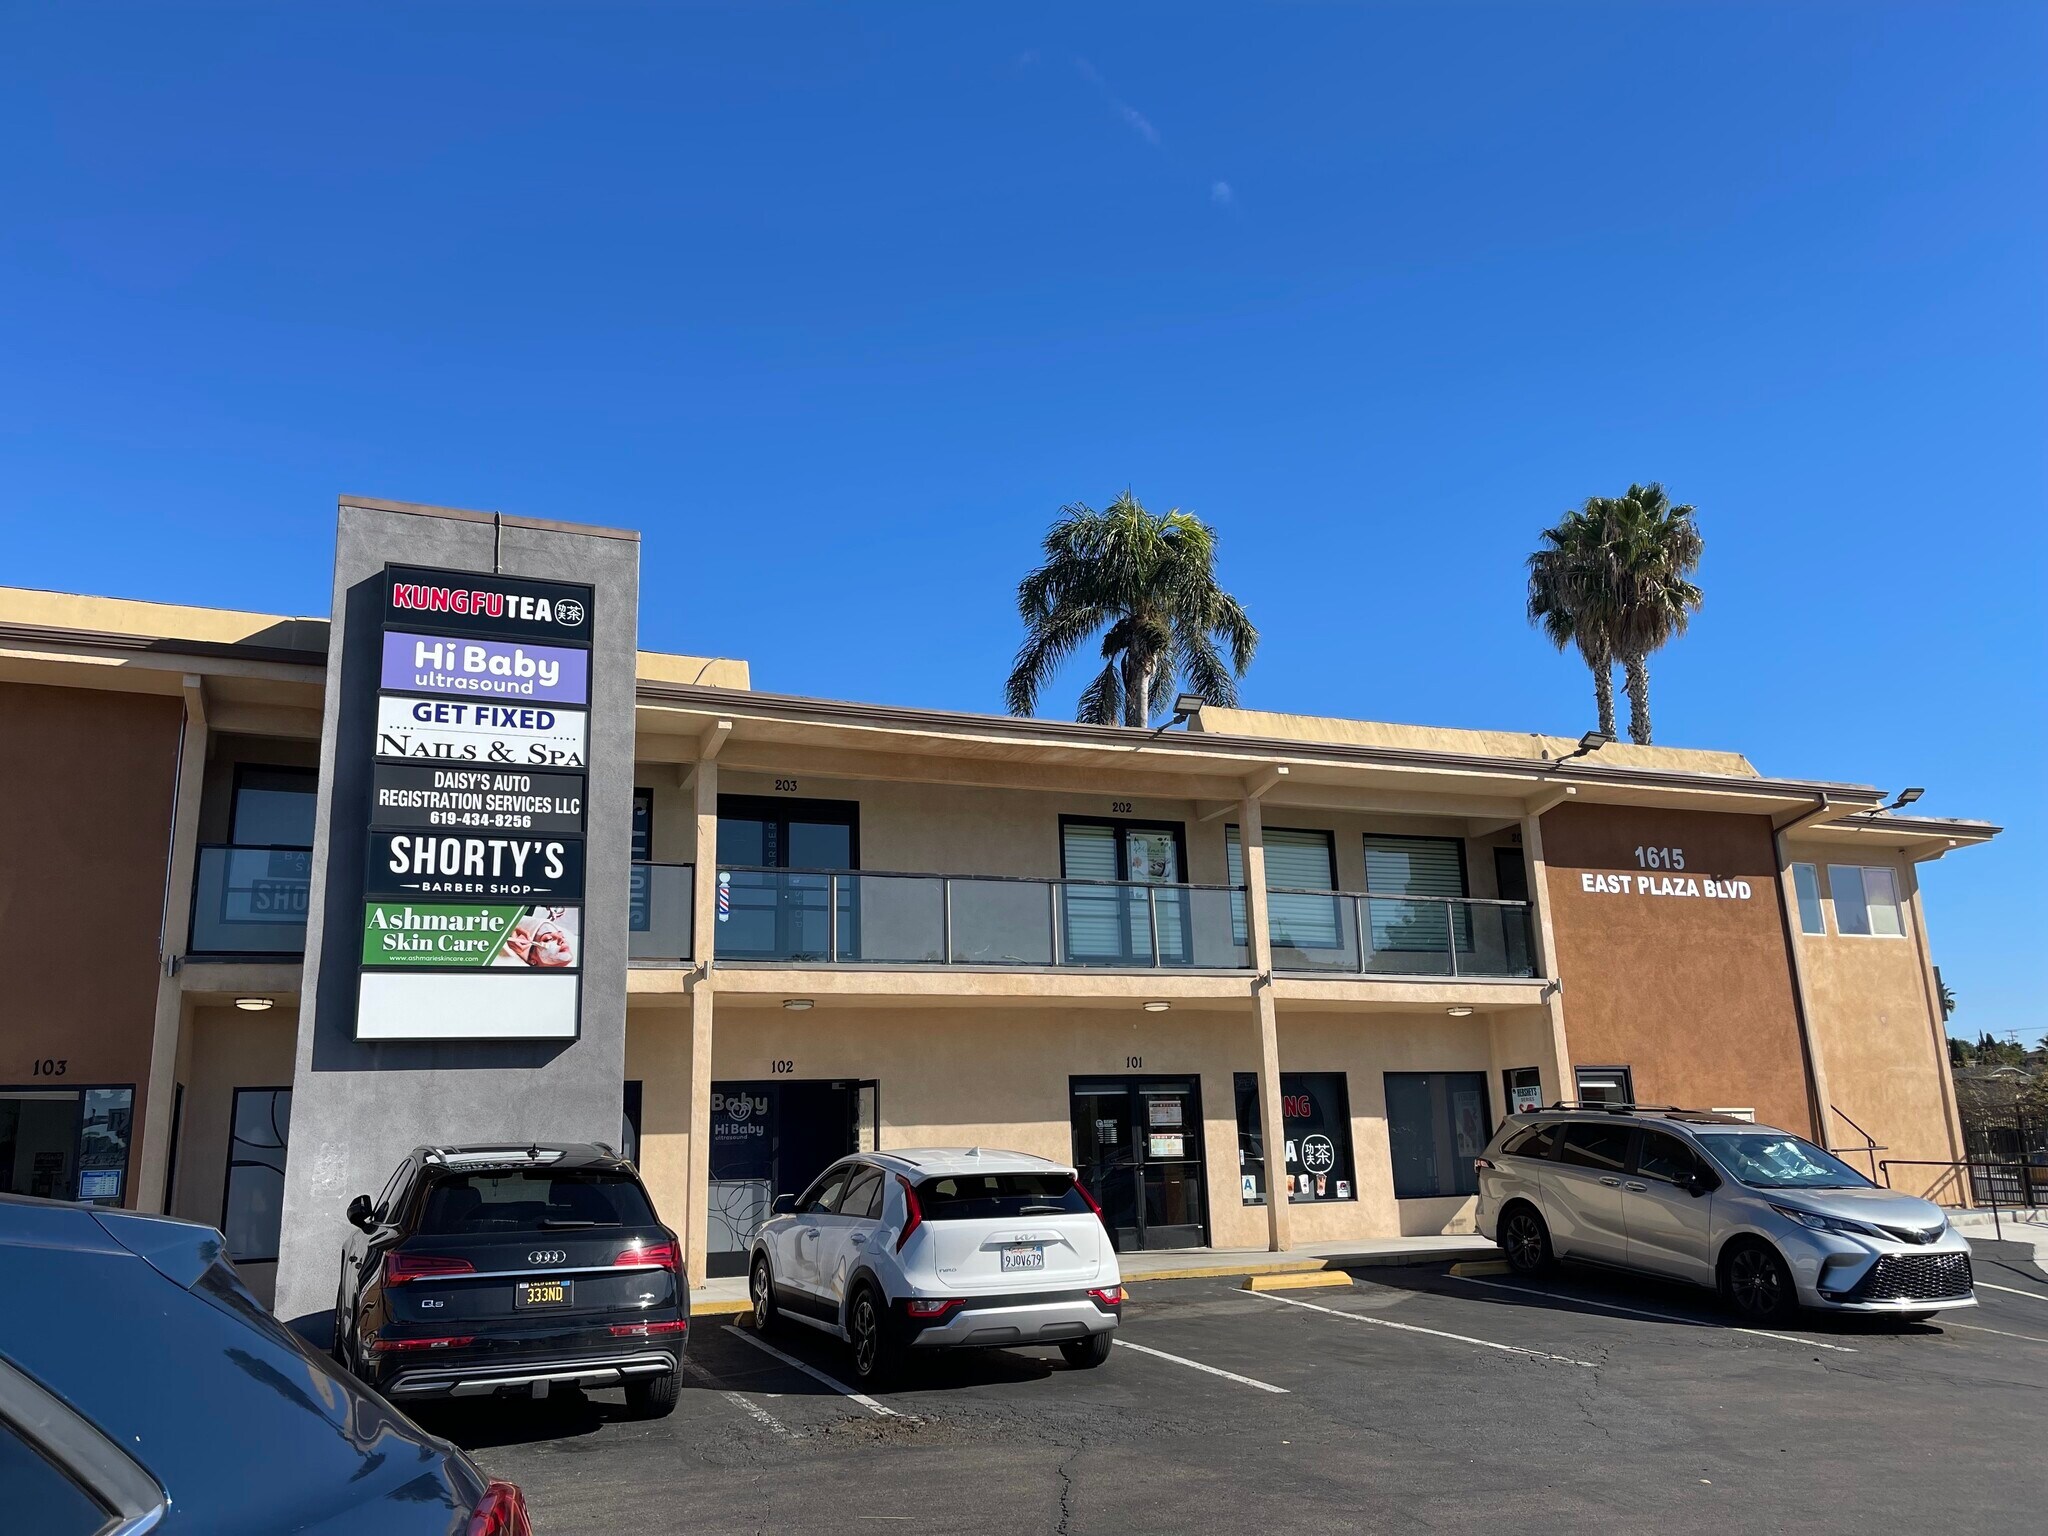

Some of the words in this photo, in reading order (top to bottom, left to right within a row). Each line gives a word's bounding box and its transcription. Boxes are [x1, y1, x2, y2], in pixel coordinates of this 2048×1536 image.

[415, 641, 456, 671] Hi
[463, 645, 560, 687] Baby
[415, 671, 534, 695] ultrasound
[412, 702, 468, 725] GET
[475, 706, 556, 730] FIXED
[377, 733, 477, 761] NAILS
[487, 741, 517, 763] &
[527, 743, 585, 767] SPA
[434, 771, 491, 792] DAISY'S
[493, 774, 531, 793] AUTO
[775, 779, 798, 792] 203
[379, 789, 482, 811] REGISTRATION
[485, 794, 552, 815] SERVICES
[555, 798, 580, 815] LLC
[1112, 802, 1132, 813] 202
[430, 811, 532, 829] 619-434-8256
[1511, 833, 1523, 843] 20
[389, 835, 565, 879] SHORTY'S
[1634, 845, 1686, 871] 1615
[422, 882, 484, 893] BARBER
[490, 884, 532, 894] SHOP
[1581, 873, 1632, 894] EAST
[1637, 876, 1701, 898] PLAZA
[1703, 879, 1752, 900] BLVD
[367, 907, 505, 933] Ashmarie
[382, 933, 434, 952] Skin
[438, 934, 490, 953] Care
[389, 954, 479, 963] www.ashmarieskincare.com
[33, 1059, 68, 1077] 103
[771, 1060, 794, 1074] 102
[1126, 1056, 1143, 1069] 101
[1283, 1095, 1311, 1118] NG
[715, 1124, 729, 1136] Hi
[731, 1122, 765, 1137] Baby
[1244, 1178, 1253, 1190] A
[527, 1286, 563, 1302] 333ND
